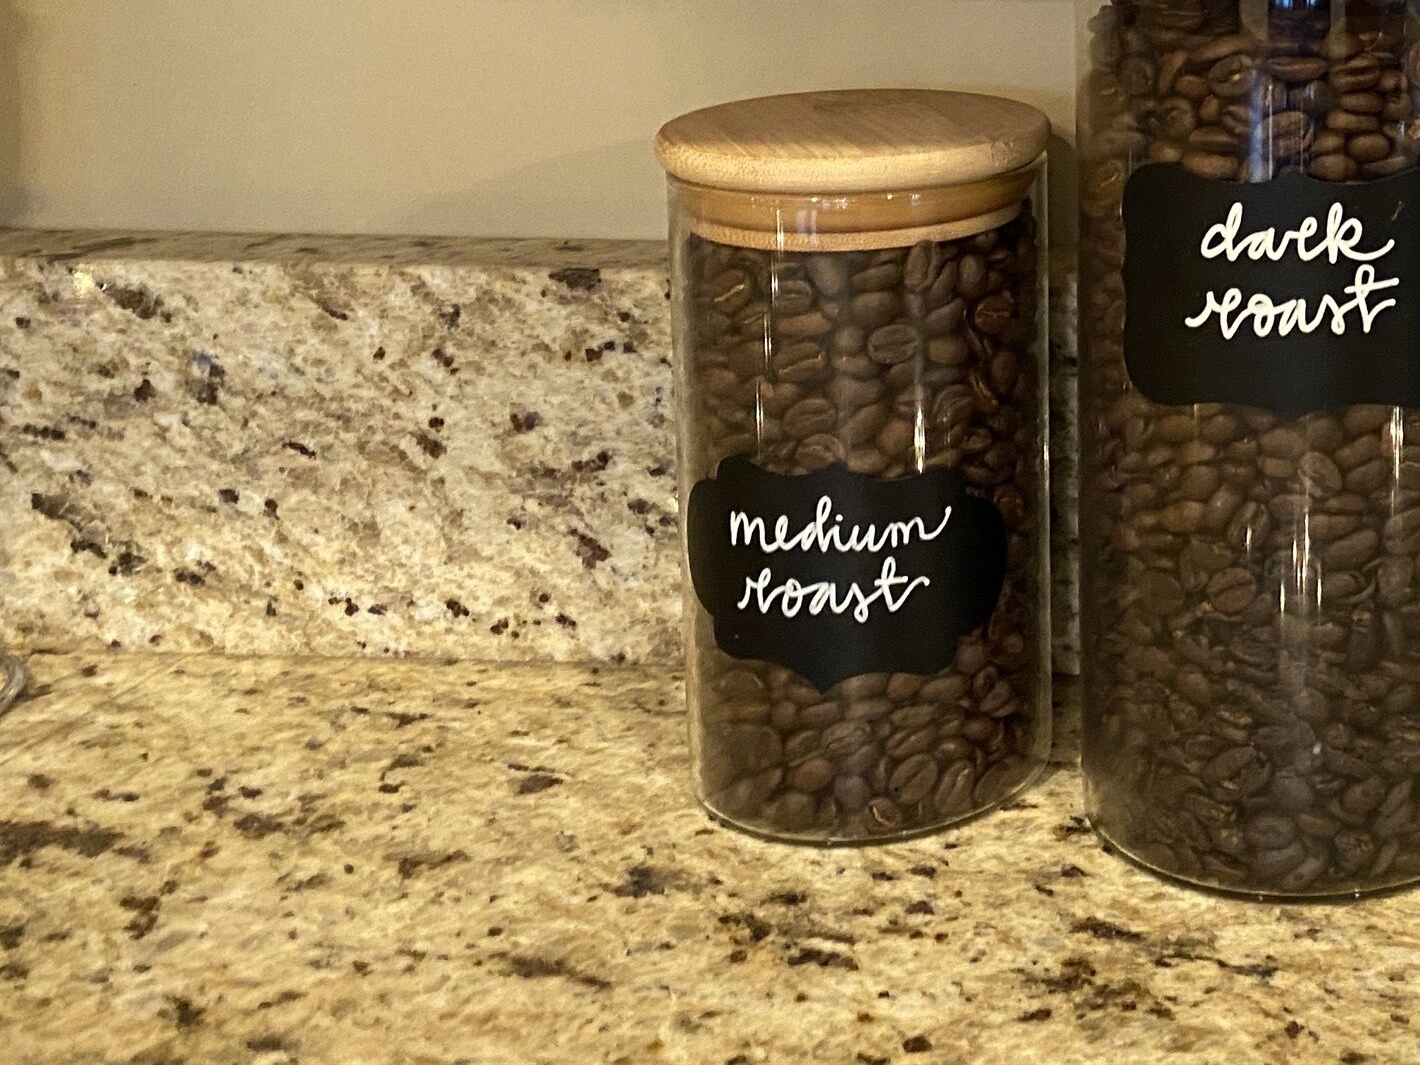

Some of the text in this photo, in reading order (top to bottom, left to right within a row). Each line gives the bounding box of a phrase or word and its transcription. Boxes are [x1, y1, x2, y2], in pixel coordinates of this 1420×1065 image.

[1200, 201, 1396, 265] dark
[1184, 263, 1400, 340] roast
[729, 495, 952, 554] medium
[737, 555, 931, 624] roast
